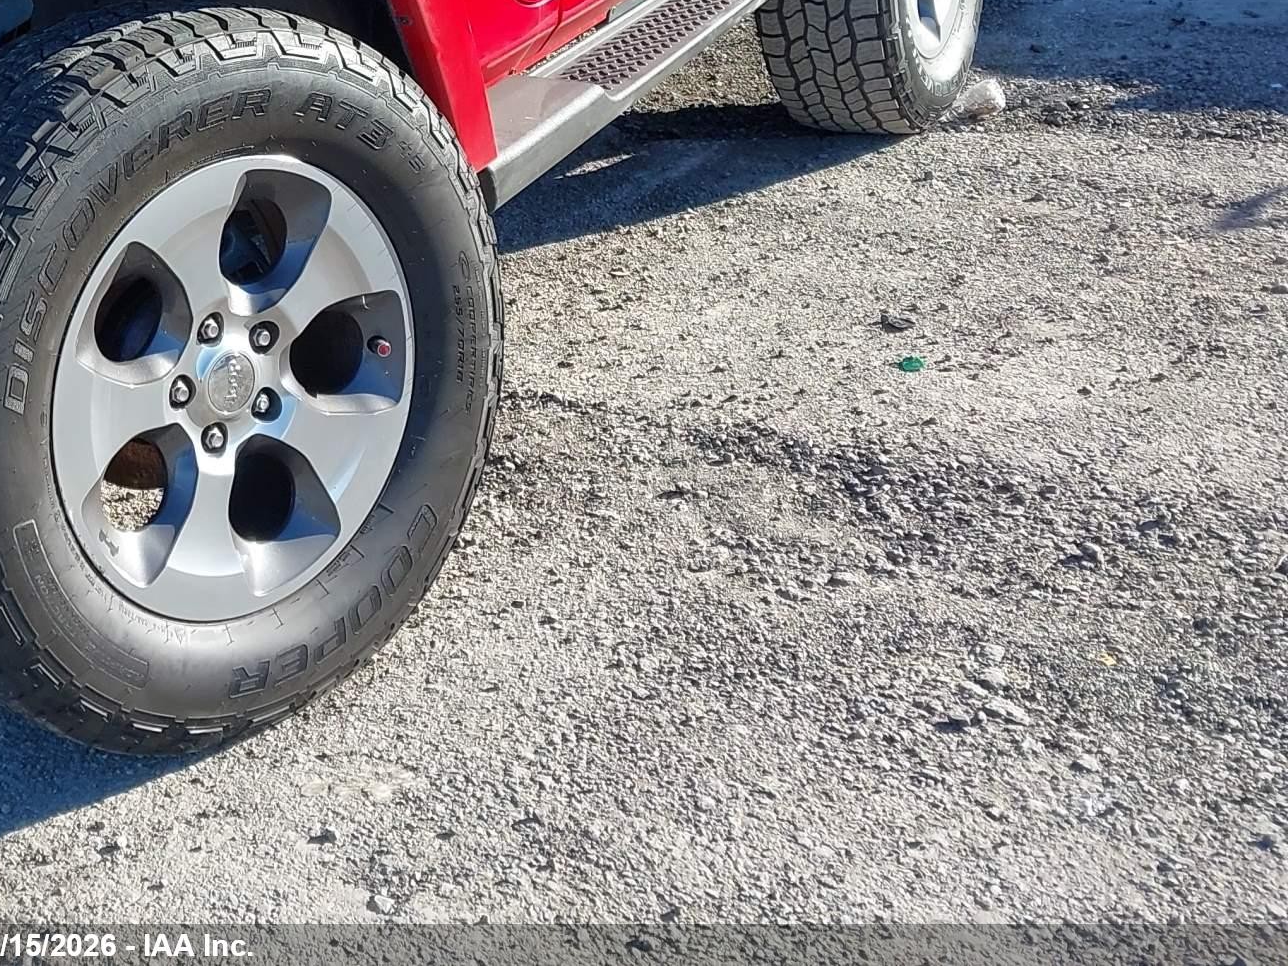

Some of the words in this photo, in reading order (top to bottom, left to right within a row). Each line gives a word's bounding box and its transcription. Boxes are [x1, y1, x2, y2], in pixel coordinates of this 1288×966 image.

[5, 87, 273, 416] DISCOVERER
[289, 91, 394, 151] AT3
[228, 503, 439, 699] COOPER
